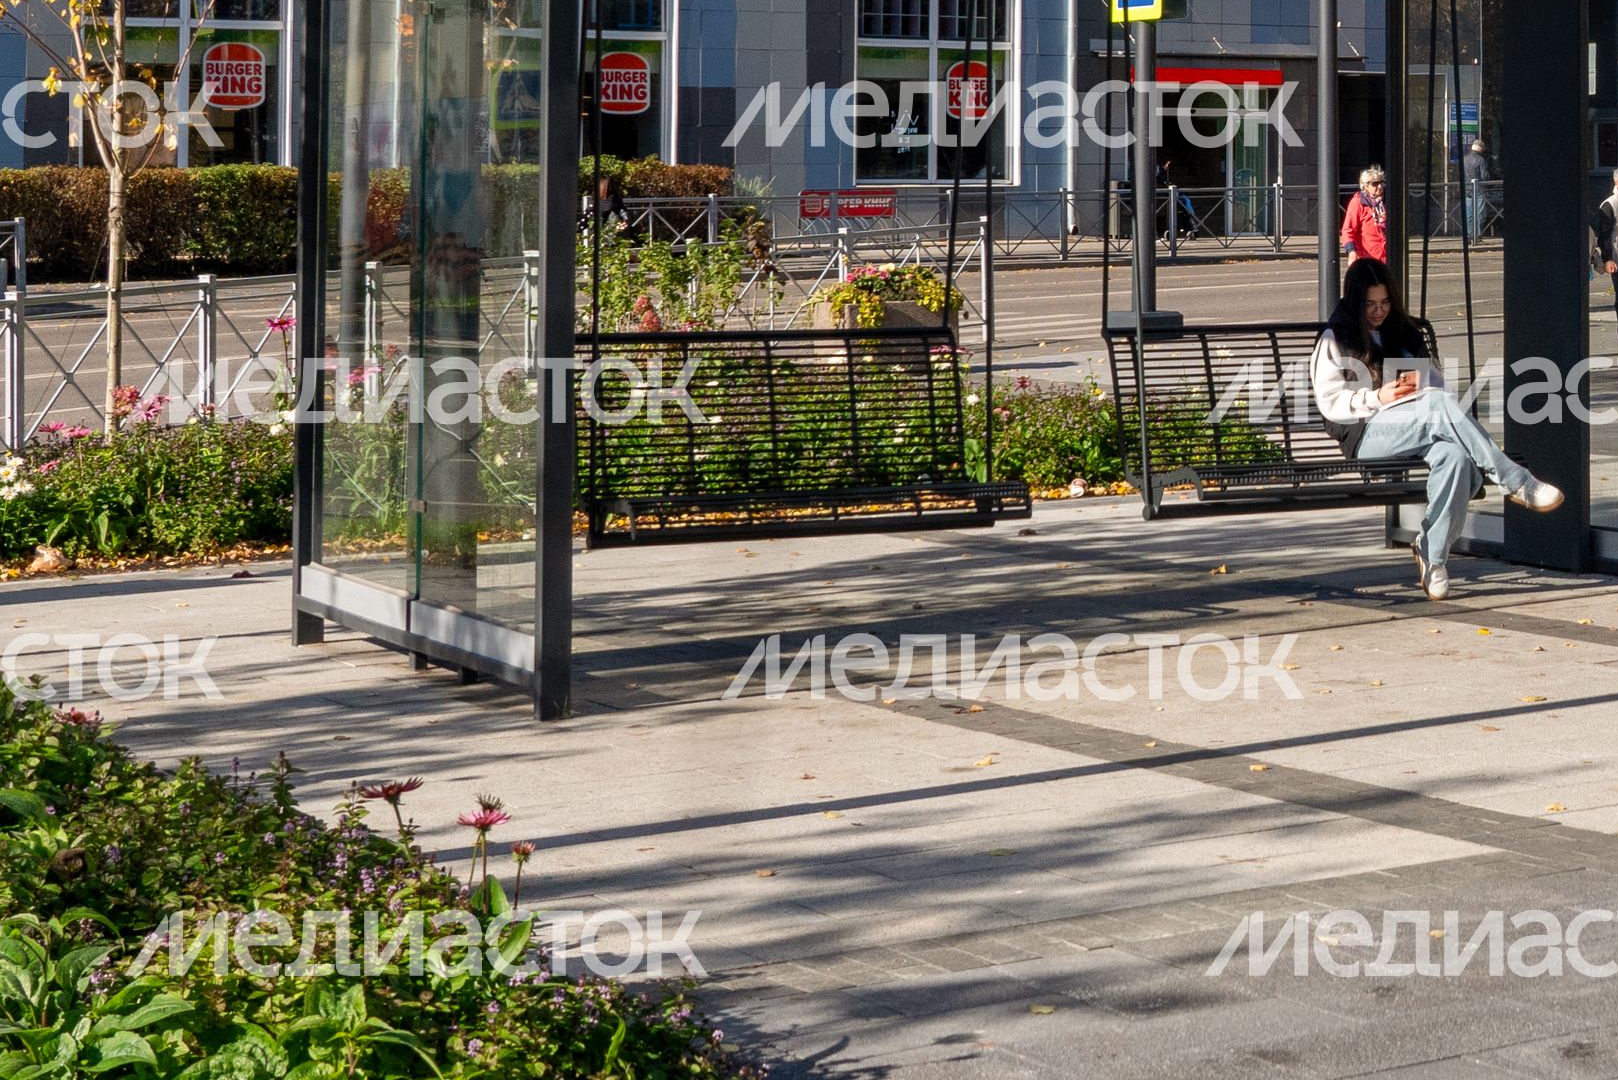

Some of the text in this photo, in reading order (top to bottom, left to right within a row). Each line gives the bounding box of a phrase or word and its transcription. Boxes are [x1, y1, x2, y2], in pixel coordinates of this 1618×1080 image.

[206, 62, 262, 75] BURGER
[205, 76, 262, 94] KING
[600, 84, 647, 100] KING
